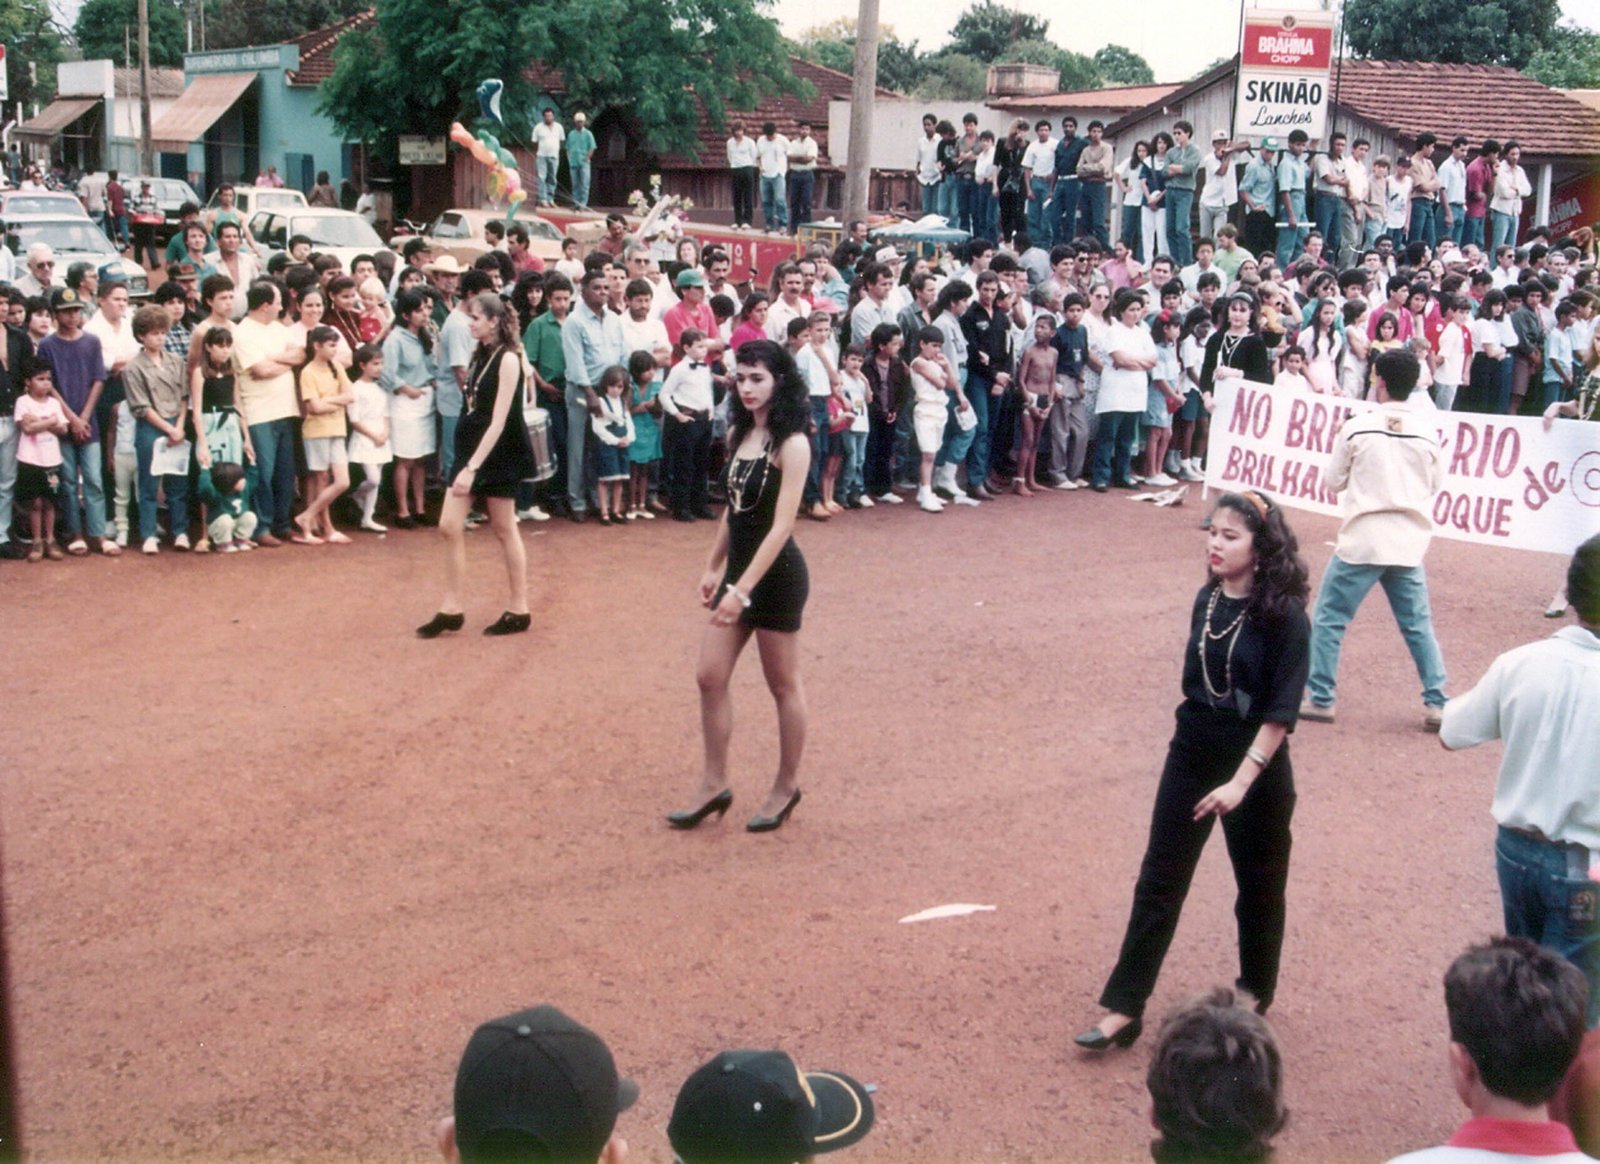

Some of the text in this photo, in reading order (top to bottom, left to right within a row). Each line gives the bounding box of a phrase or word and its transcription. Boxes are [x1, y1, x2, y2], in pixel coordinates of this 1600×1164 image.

[1258, 36, 1315, 55] BRAHMA
[1270, 54, 1301, 64] CHOPP
[1245, 78, 1322, 105] SKINÃO
[1250, 105, 1312, 127] Lanches
[1228, 386, 1272, 439] NO
[1448, 421, 1521, 479] RIO
[1523, 460, 1566, 511] de
